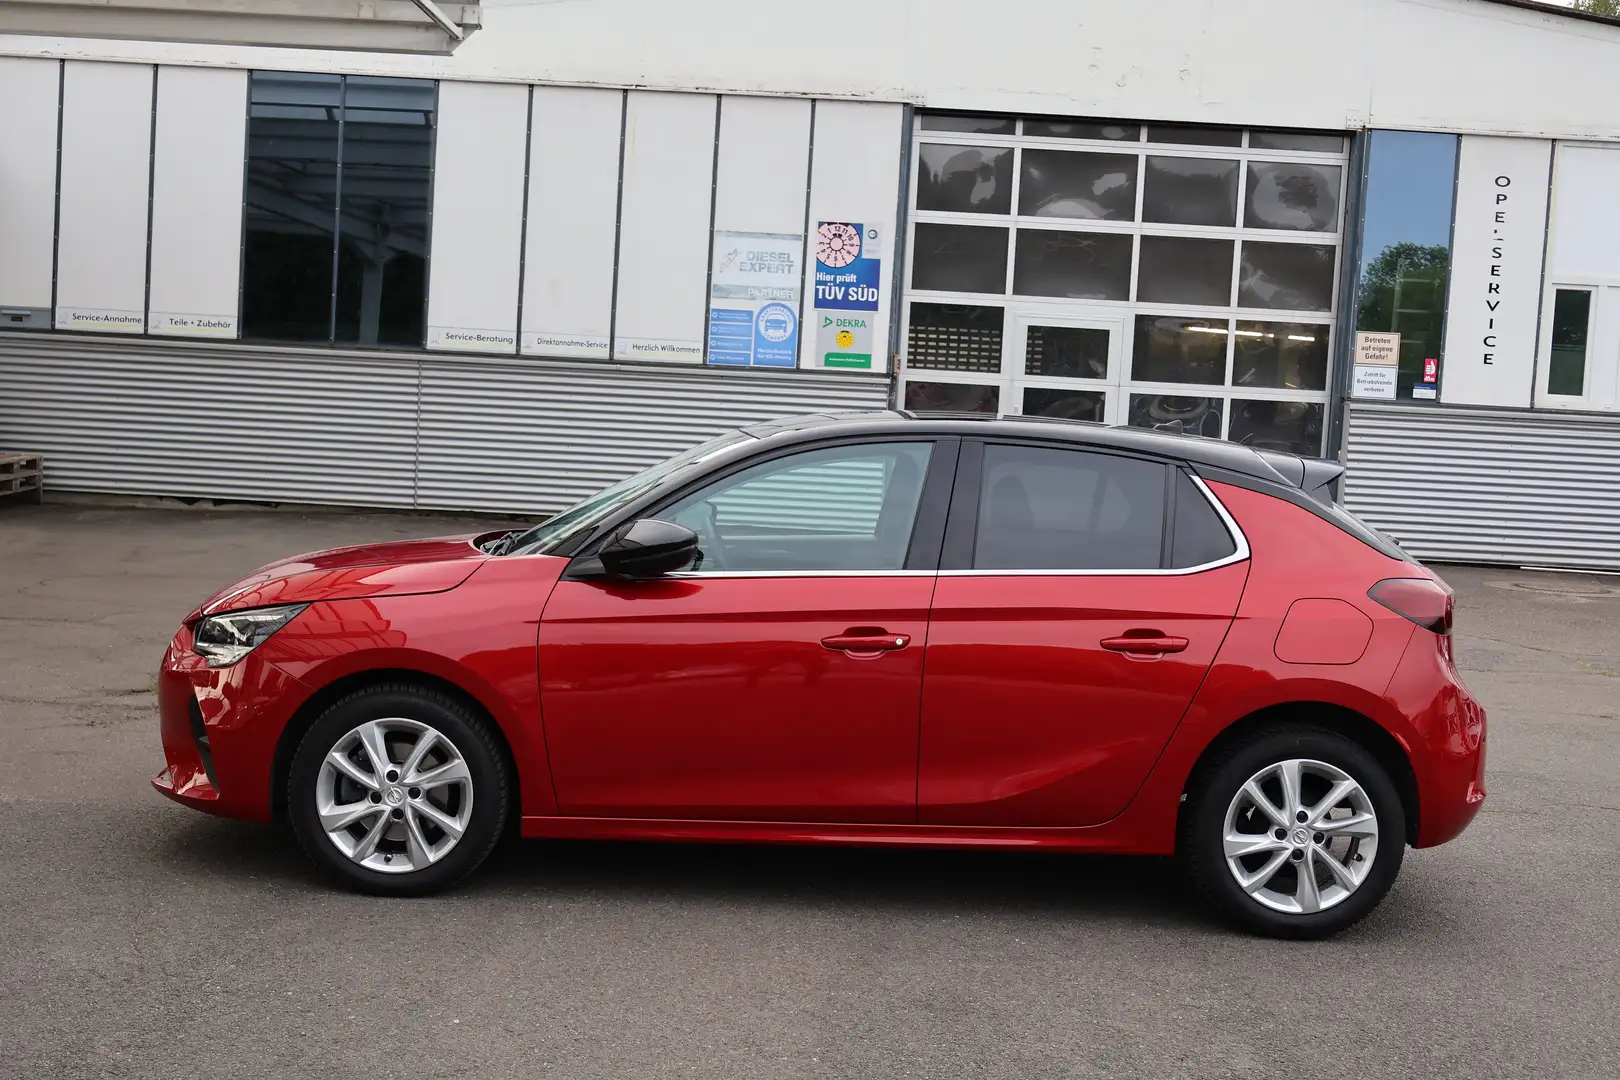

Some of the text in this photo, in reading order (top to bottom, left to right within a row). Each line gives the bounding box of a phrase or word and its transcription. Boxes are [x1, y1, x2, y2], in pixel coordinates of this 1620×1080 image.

[746, 251, 794, 264] DIESEL
[739, 261, 794, 274] EXPERT
[816, 272, 857, 284] Hier prüft
[747, 288, 794, 299] PARTNER
[816, 283, 878, 302] TÜV SÜD
[72, 313, 142, 324] Service-Annahme
[169, 318, 188, 326] Teile
[197, 319, 232, 329] Zubehör
[836, 318, 866, 328] DEKRA
[445, 332, 514, 345] Service-Beratung
[537, 337, 608, 350] Direktannahme-Service
[1364, 336, 1391, 344] Betreten
[632, 343, 700, 354] Herzlich Willkommen
